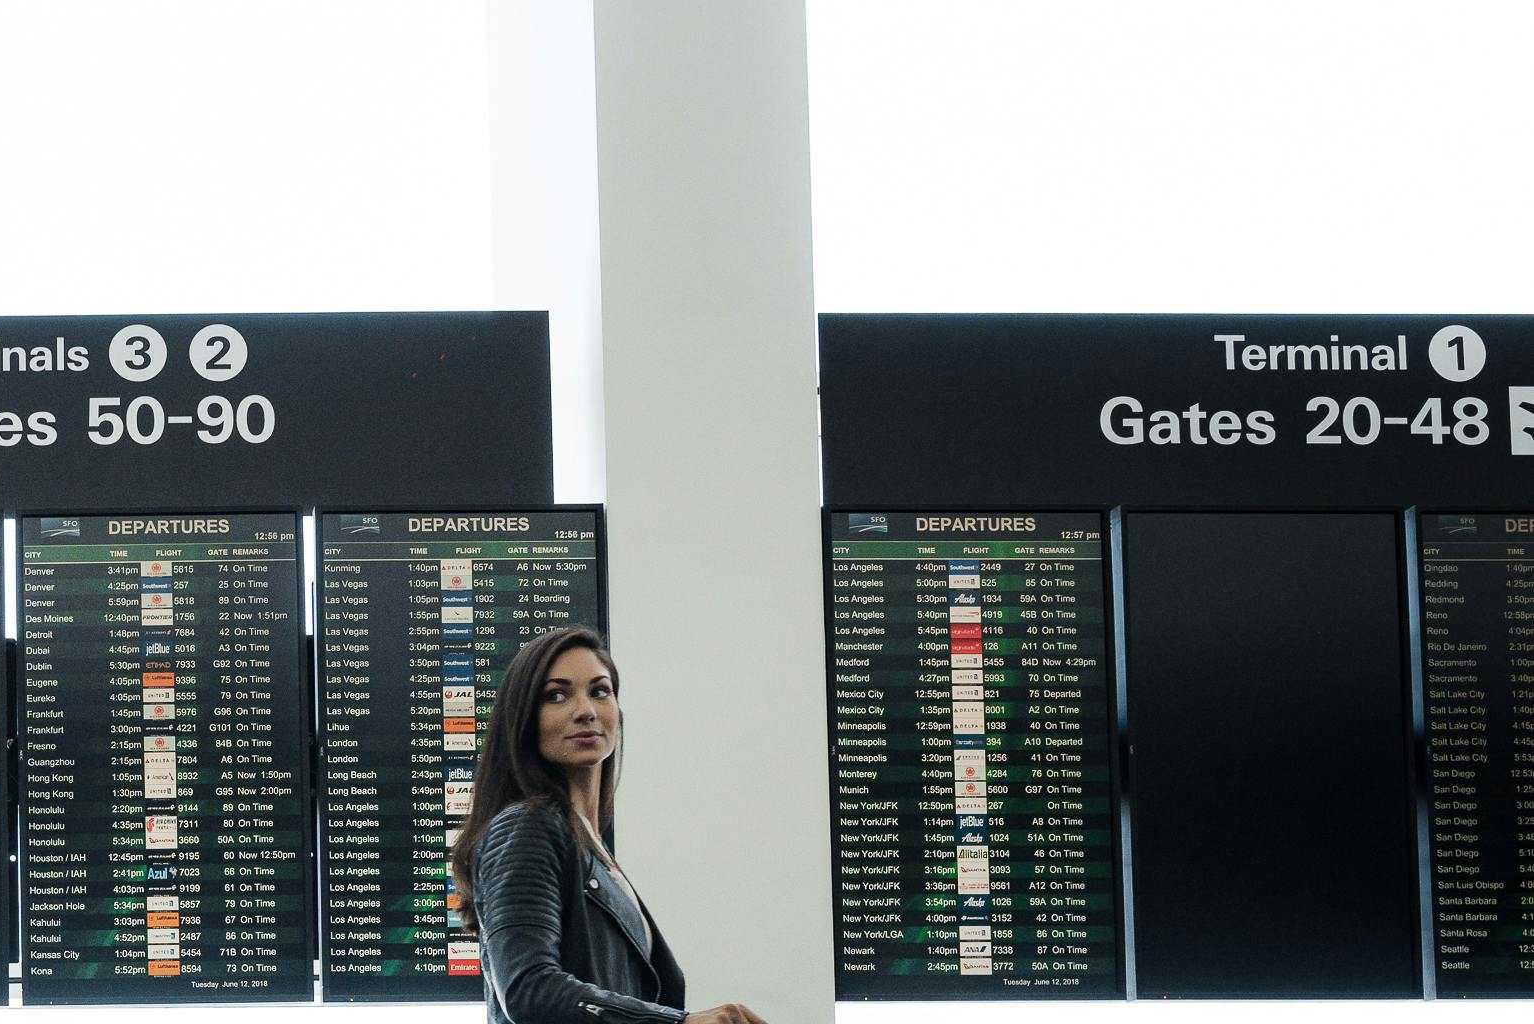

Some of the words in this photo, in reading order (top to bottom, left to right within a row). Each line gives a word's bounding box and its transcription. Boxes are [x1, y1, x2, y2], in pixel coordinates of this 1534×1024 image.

[1214, 334, 1407, 372] Terminal
[87, 395, 276, 445] 50-90
[1100, 397, 1276, 446] Gates
[1305, 396, 1489, 445] 20-48
[108, 519, 230, 535] DEPARTURES
[408, 517, 530, 532] DEPARTURES
[916, 517, 1036, 532] DEPARTURES
[1426, 596, 1464, 604] Redmond
[25, 615, 42, 623] Des
[44, 615, 74, 623] Moines
[104, 614, 139, 623] 12:40pm
[175, 613, 194, 621] 1756
[219, 612, 229, 620] 22
[234, 612, 252, 620] Now
[258, 612, 288, 621] 1:51pm
[836, 642, 883, 651] Manchester
[918, 642, 948, 652] 4:00pm
[984, 642, 998, 651] 126
[1021, 642, 1037, 650] A11
[1042, 642, 1057, 651] On
[1059, 642, 1077, 651] Time
[1428, 643, 1443, 651] Rio
[1445, 643, 1455, 651] De
[1457, 643, 1486, 651] Janeiro
[327, 691, 339, 699] Las
[342, 691, 370, 701] Vegas
[410, 690, 440, 700] 4:55pm
[476, 690, 496, 698] 5452
[841, 850, 858, 858] New
[860, 850, 899, 858] York/JFK
[924, 850, 955, 860] 2:10pm
[959, 849, 988, 858] Alitalia
[990, 850, 1010, 858] 3104
[1034, 850, 1044, 858] 46
[1049, 850, 1064, 858] On
[1066, 850, 1084, 858] Time
[29, 870, 63, 879] Houston
[71, 870, 86, 878] IAH
[113, 869, 144, 879] 2:41pm
[148, 867, 168, 879] Azul
[224, 868, 235, 876] 66
[240, 867, 254, 876] On
[256, 867, 275, 875] Time
[1476, 881, 1504, 890] Obispo
[331, 964, 343, 972] Los
[345, 964, 382, 974] Angeles
[415, 963, 445, 973] 4:10pm
[450, 964, 478, 972] Emirates
